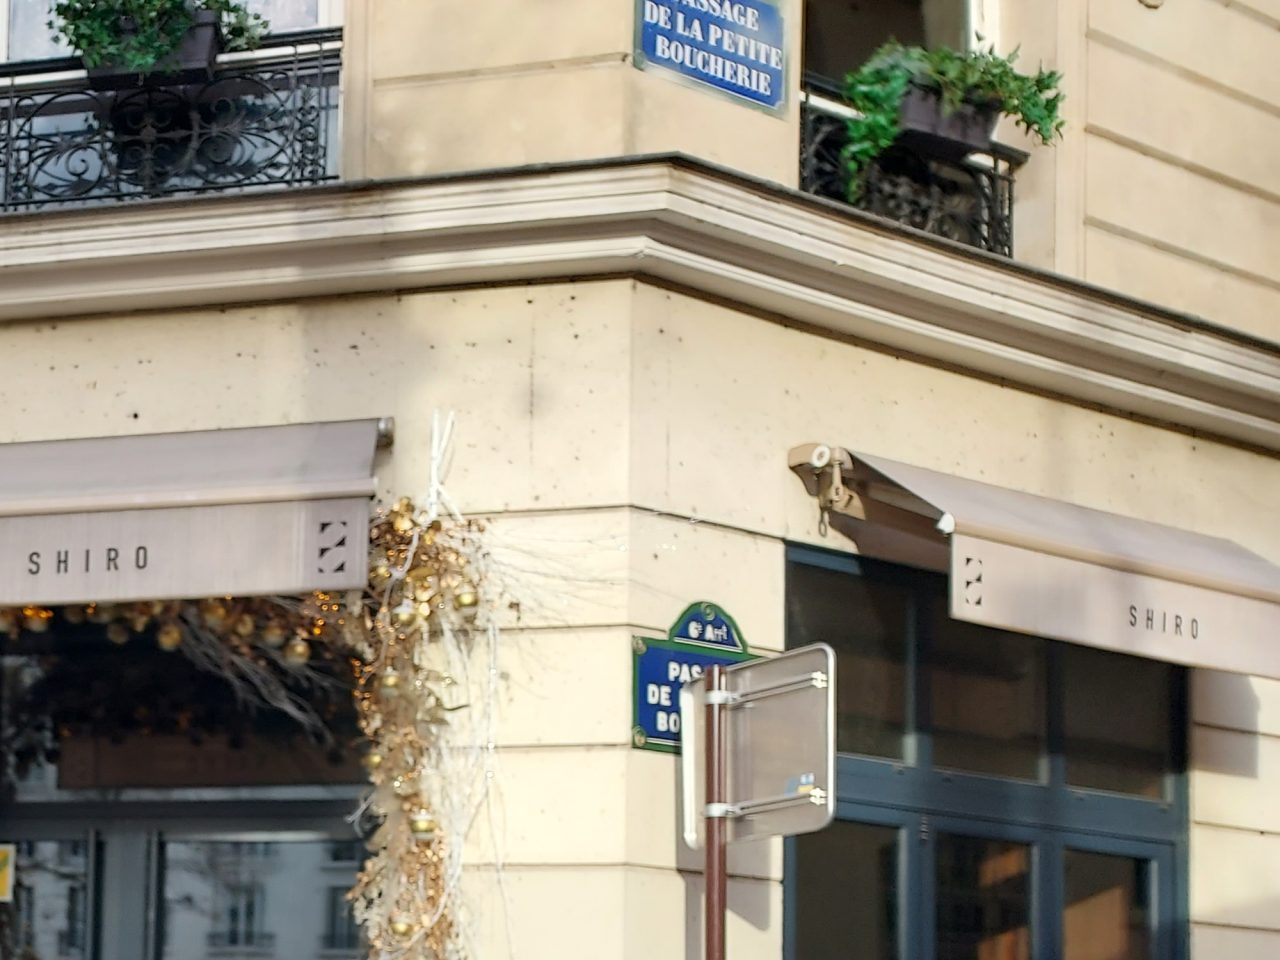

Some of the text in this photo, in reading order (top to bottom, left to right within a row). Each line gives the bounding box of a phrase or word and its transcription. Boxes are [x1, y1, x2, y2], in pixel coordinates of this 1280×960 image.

[676, 0, 759, 31] SSAGE
[644, 0, 783, 70] DE LA PETITE
[656, 34, 771, 95] BOUCHERIE
[27, 546, 148, 575] SHIRO
[1129, 604, 1199, 639] SHIRO
[668, 661, 704, 683] PAS
[647, 683, 672, 706] DE
[656, 710, 681, 733] BO
